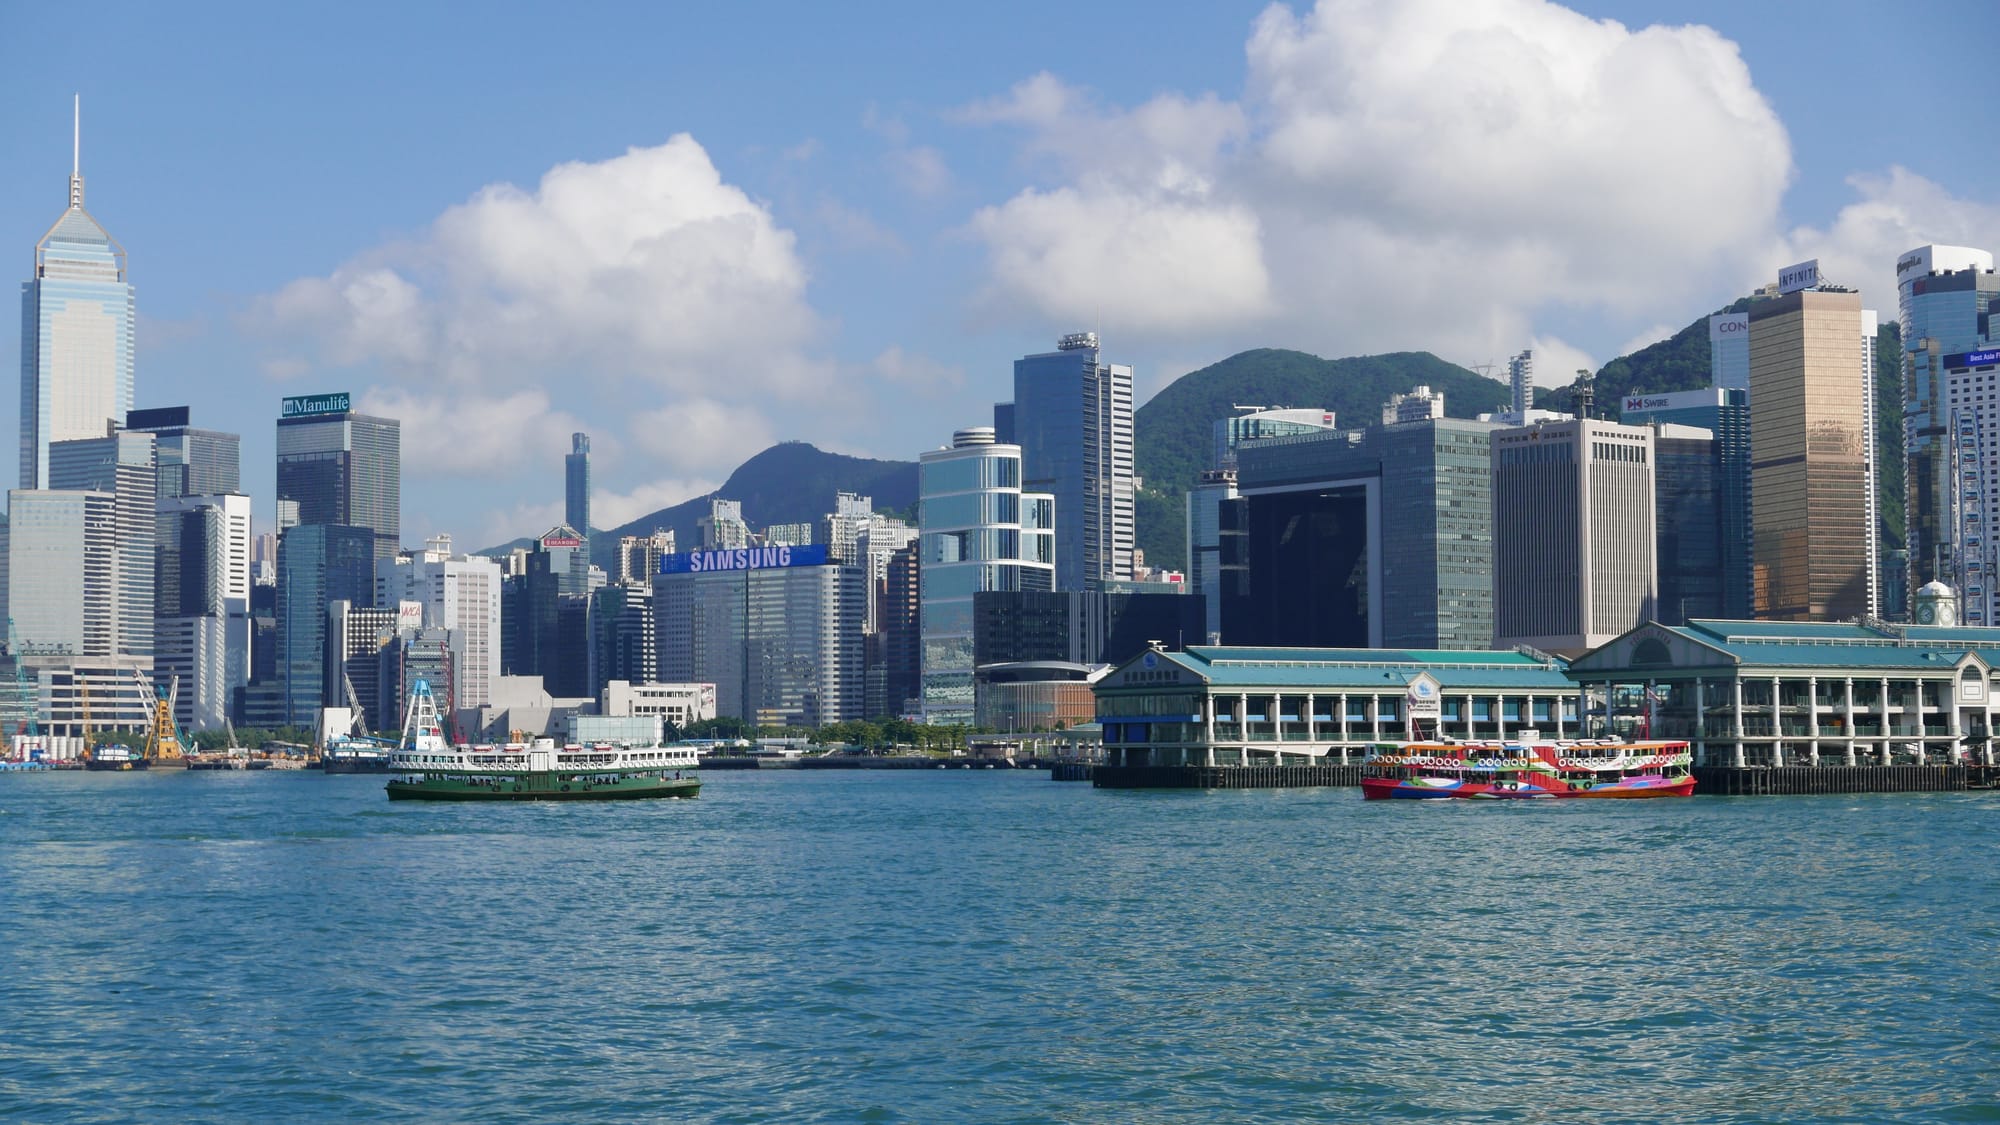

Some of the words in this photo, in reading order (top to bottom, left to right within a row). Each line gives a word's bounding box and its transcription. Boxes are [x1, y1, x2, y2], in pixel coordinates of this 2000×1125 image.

[1779, 266, 1817, 288] INFINITI
[1719, 320, 1747, 333] CON
[1970, 354, 1983, 362] Best
[295, 396, 348, 414] Manulife
[690, 547, 791, 572] SAMSUNG
